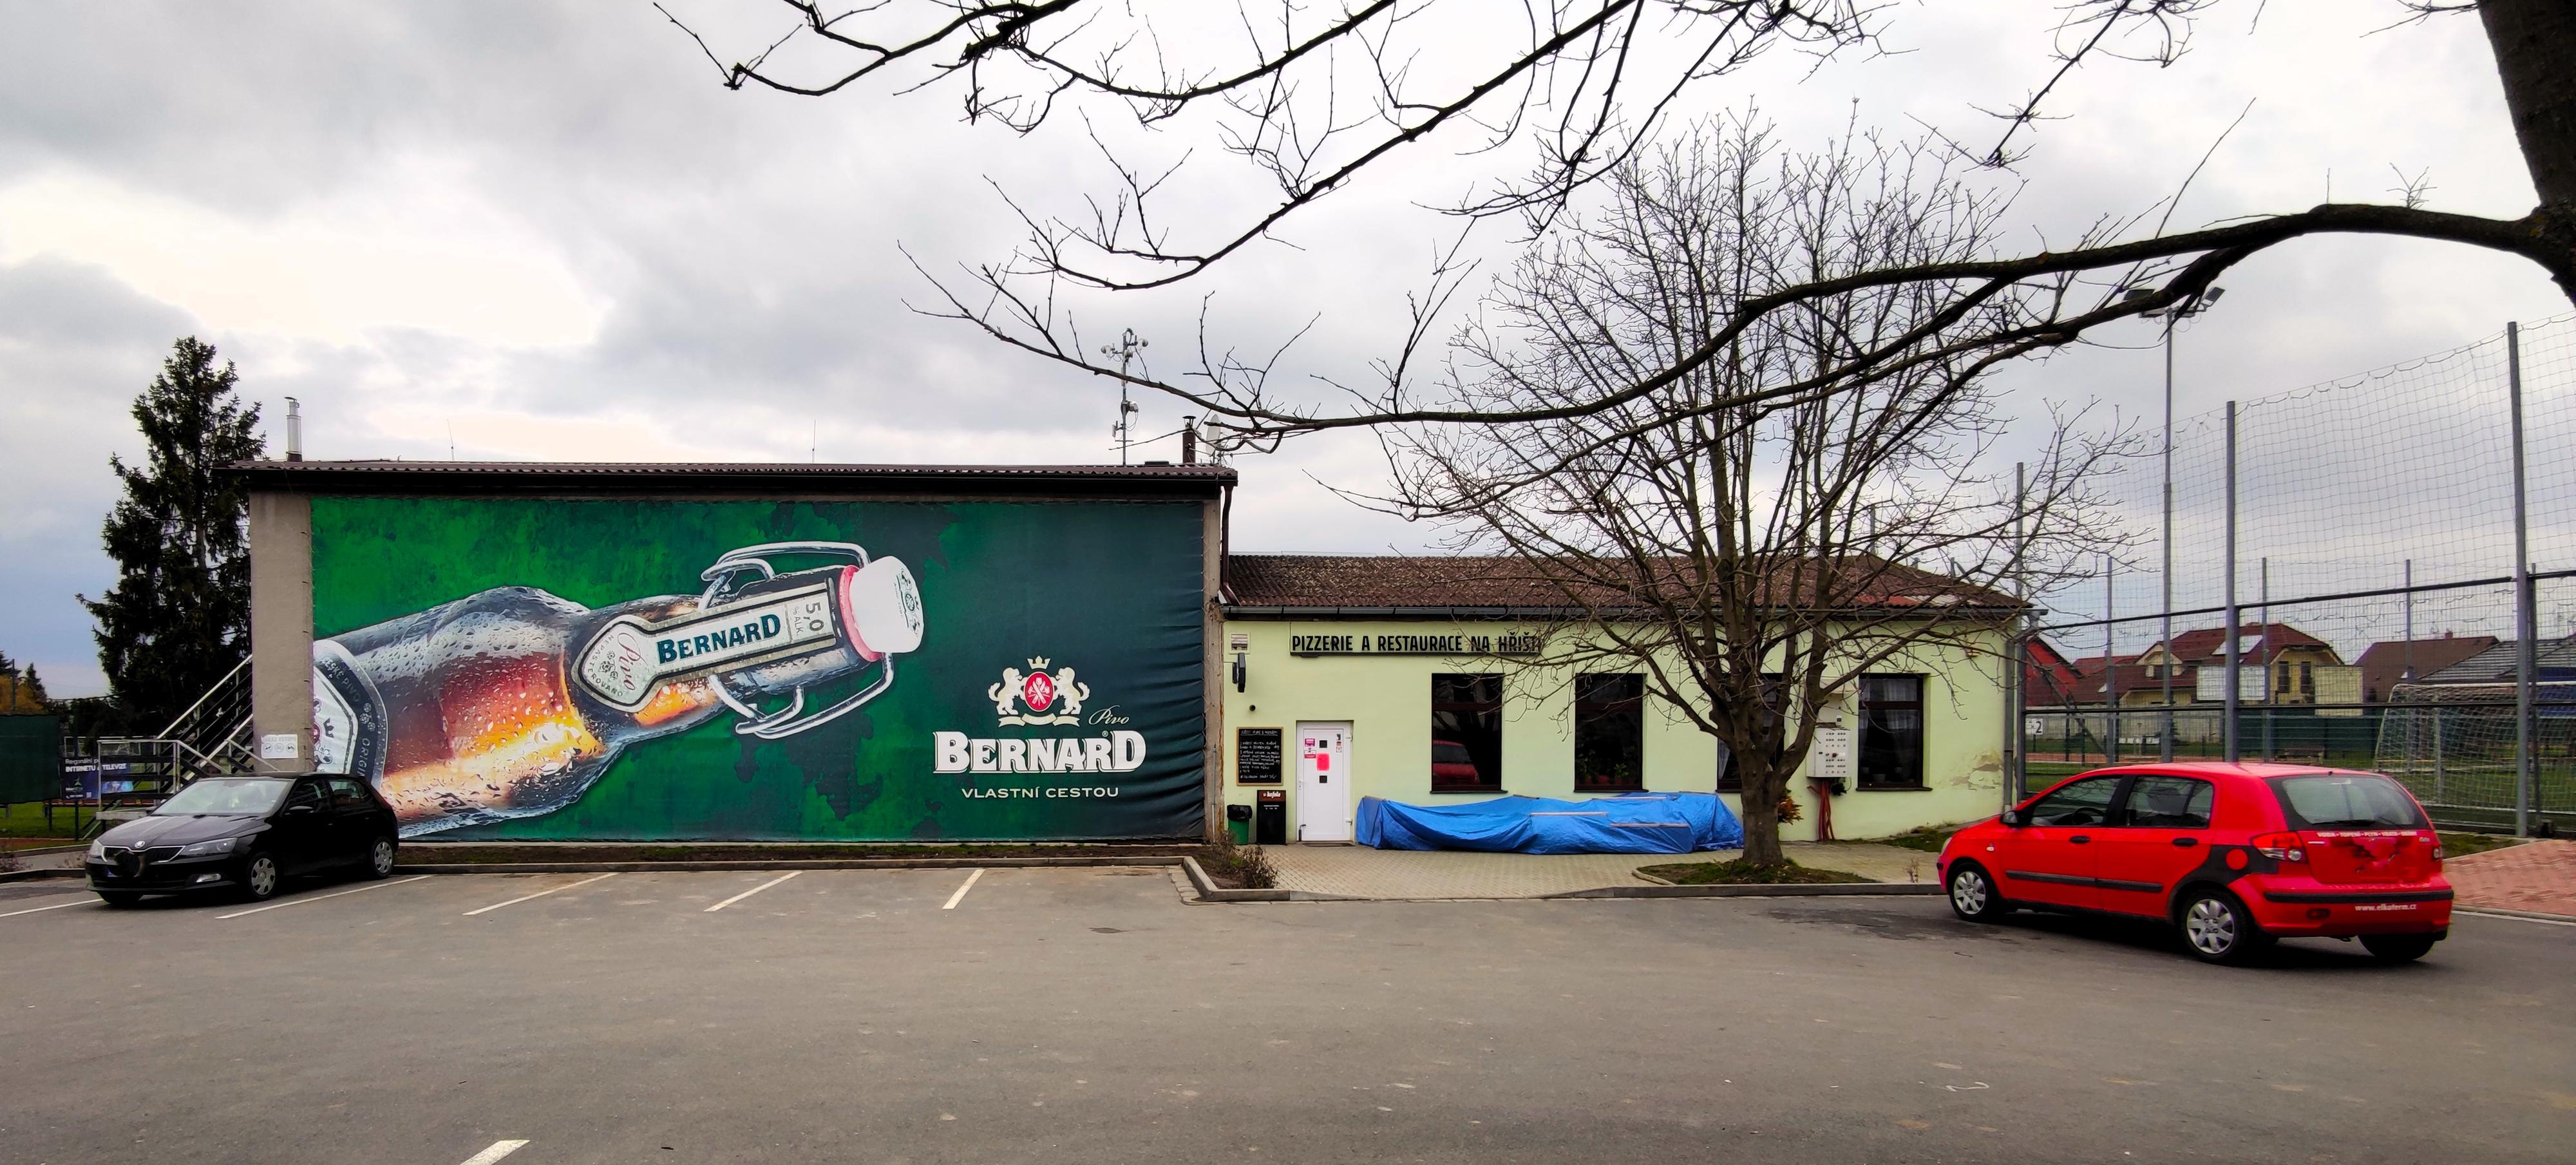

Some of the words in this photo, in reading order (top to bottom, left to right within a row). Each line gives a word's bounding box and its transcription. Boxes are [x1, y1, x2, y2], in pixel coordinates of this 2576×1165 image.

[657, 614, 781, 664] BERNARD
[1292, 636, 1352, 651] PIZZERIE
[1361, 636, 1370, 651] A
[1378, 636, 1463, 651] RESTAURACE
[1471, 636, 1490, 651] NA
[617, 632, 650, 691] Pivo
[1088, 705, 1130, 726] Pivo
[933, 730, 1147, 774] BERNARD
[961, 786, 1040, 799] VLASTNÍ
[1045, 787, 1119, 799] CESTOU
